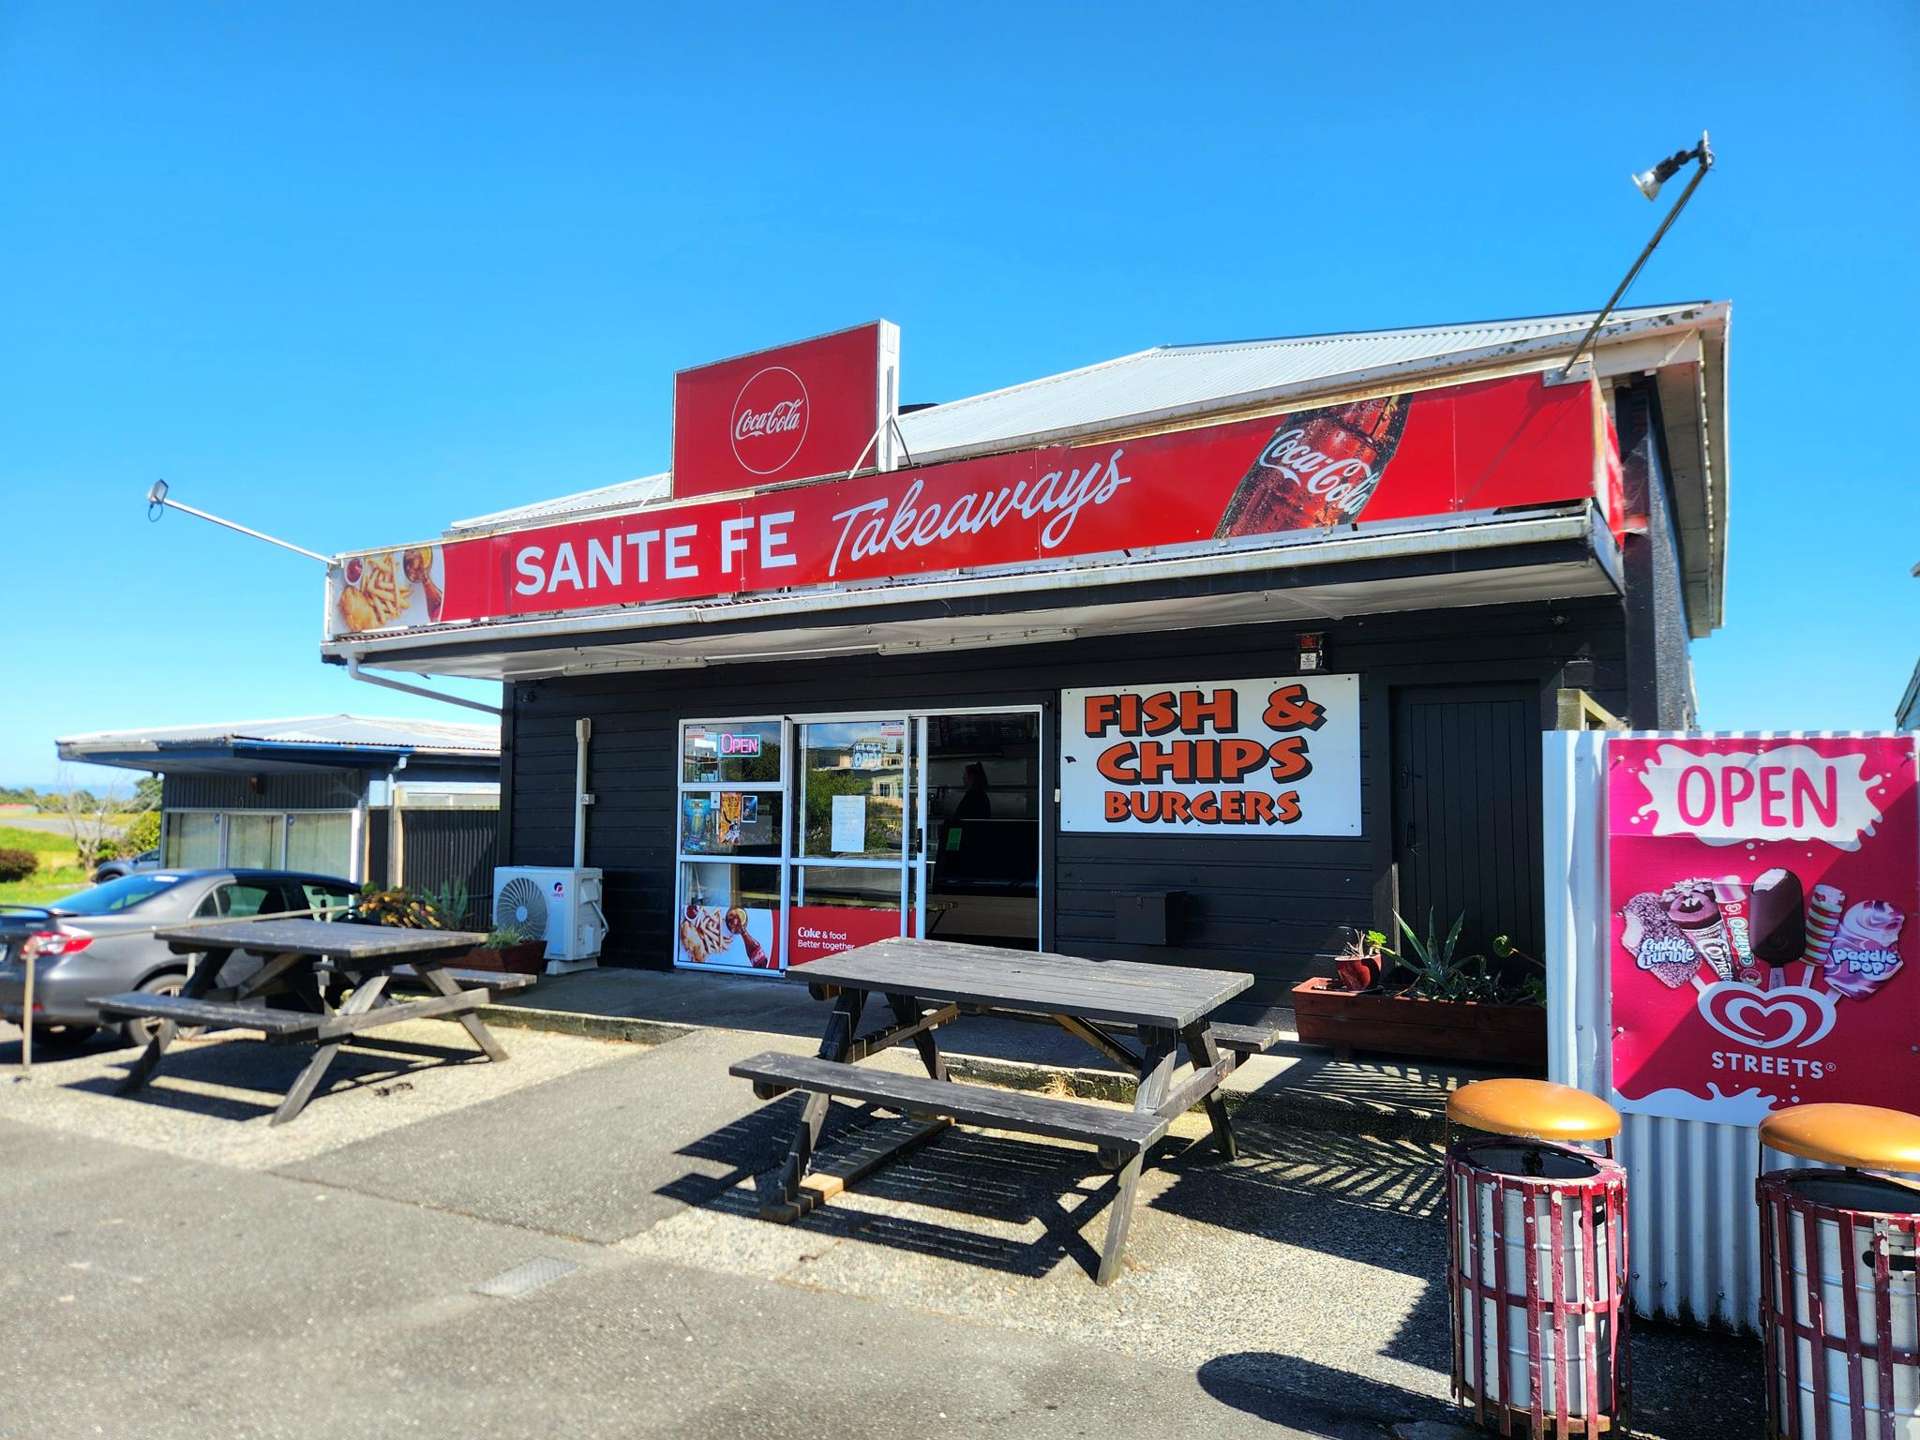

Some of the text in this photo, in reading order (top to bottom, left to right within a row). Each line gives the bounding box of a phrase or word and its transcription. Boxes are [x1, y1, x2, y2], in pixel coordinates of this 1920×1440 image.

[735, 398, 805, 440] Coca-Cola
[1259, 428, 1380, 515] Coca-Cola
[515, 448, 1132, 596] SANTE FE Takeaways
[1084, 684, 1328, 738] FISH &
[721, 733, 758, 754] OPEN
[1096, 736, 1313, 784] CHIPS
[1104, 790, 1303, 826] BURGERS
[1677, 765, 1839, 828] OPEN
[797, 927, 847, 940] Coke & food
[797, 940, 855, 952] Better together
[1641, 936, 1686, 952] Cookie
[1637, 947, 1697, 970] Crumble
